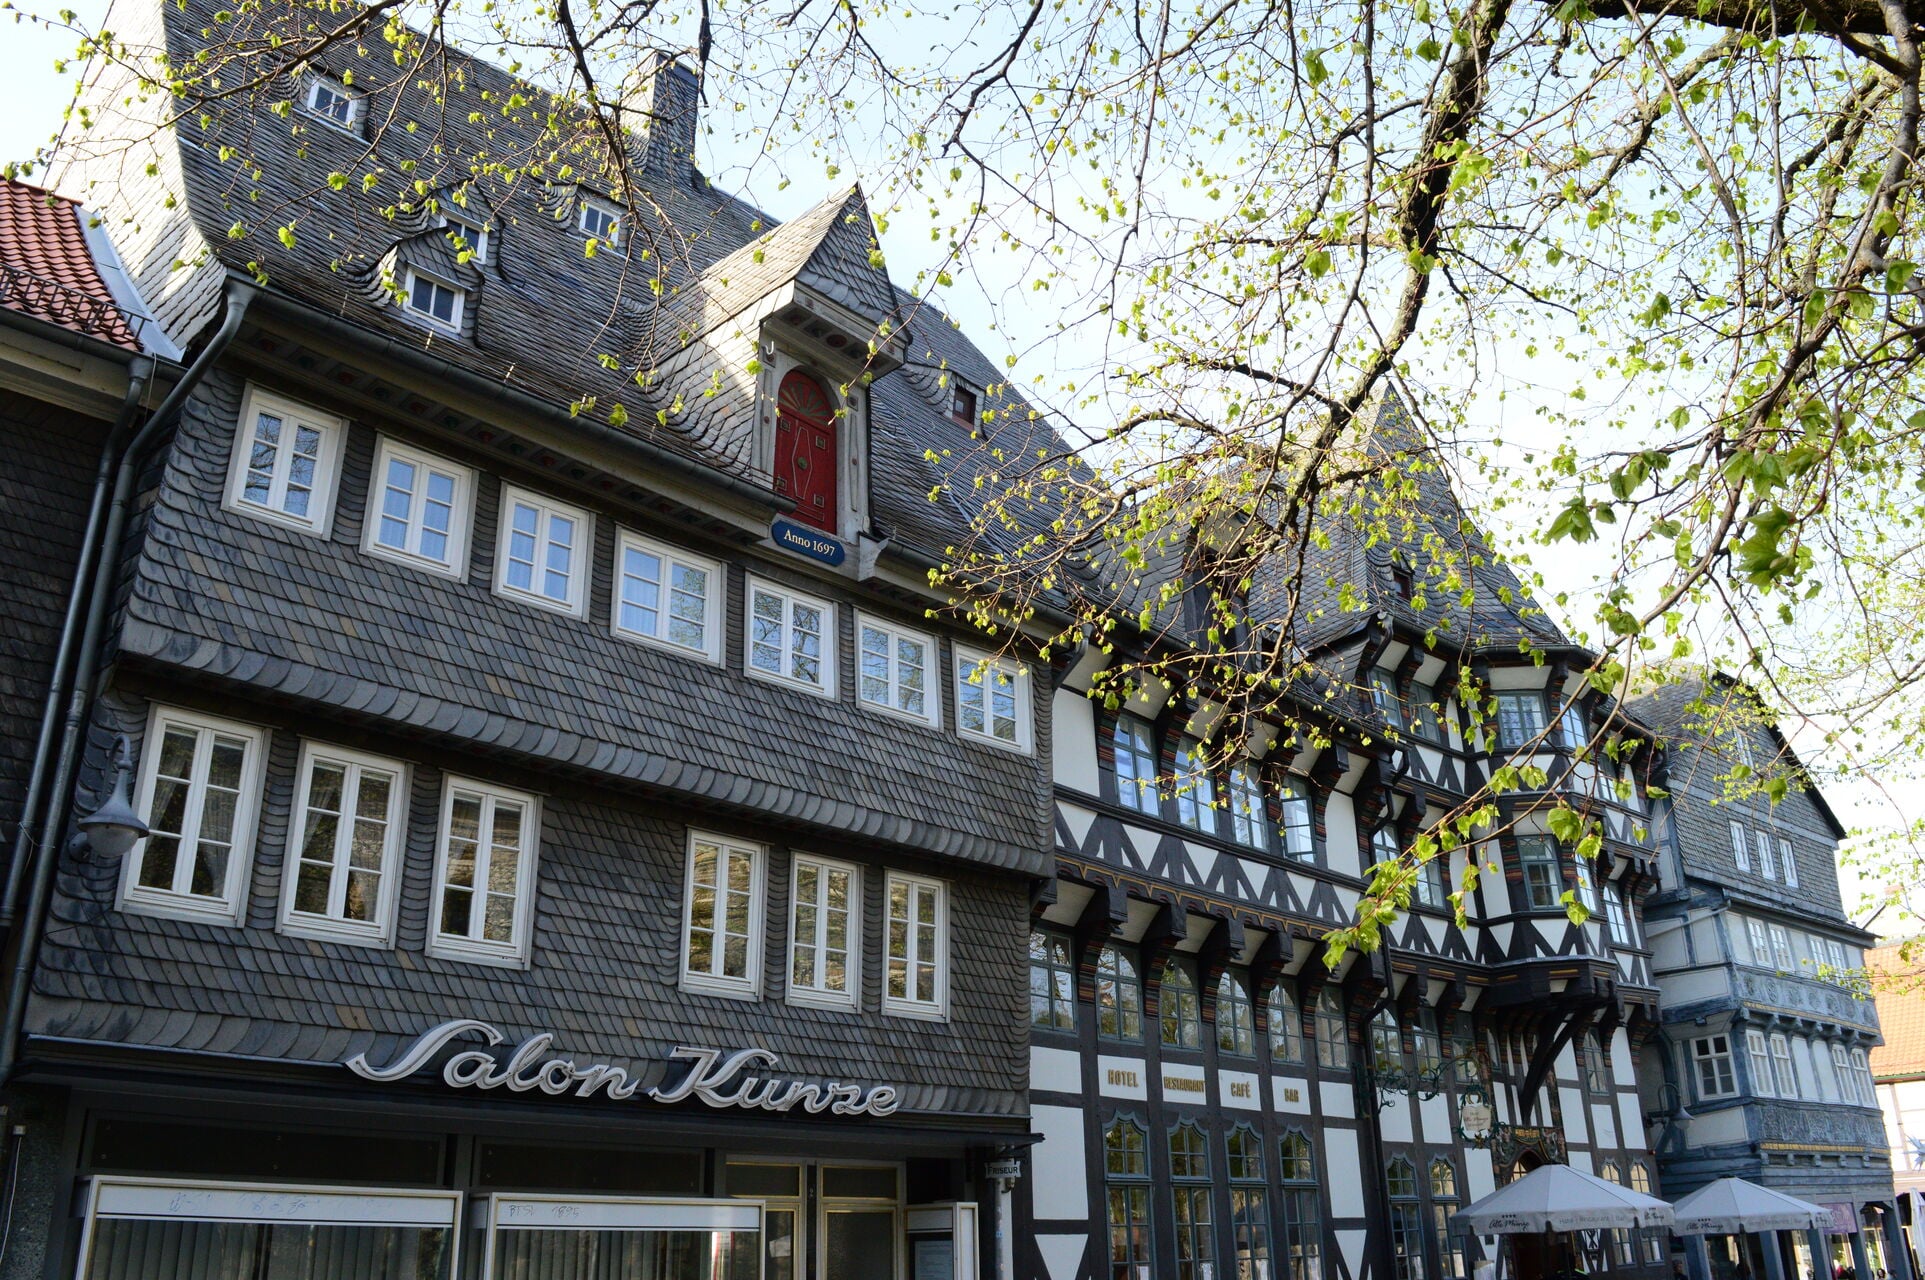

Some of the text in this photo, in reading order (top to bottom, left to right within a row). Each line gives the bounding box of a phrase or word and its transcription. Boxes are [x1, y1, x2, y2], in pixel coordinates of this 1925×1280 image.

[783, 529, 836, 557] Anno 1697
[345, 1019, 899, 1117] Salon Kunze
[1107, 1069, 1139, 1088] HOTEL
[1163, 1076, 1206, 1093] RESTAURANT
[1230, 1081, 1252, 1099] CAFÉ
[1284, 1088, 1300, 1103] BAR
[987, 1166, 1018, 1176] FRISEUR
